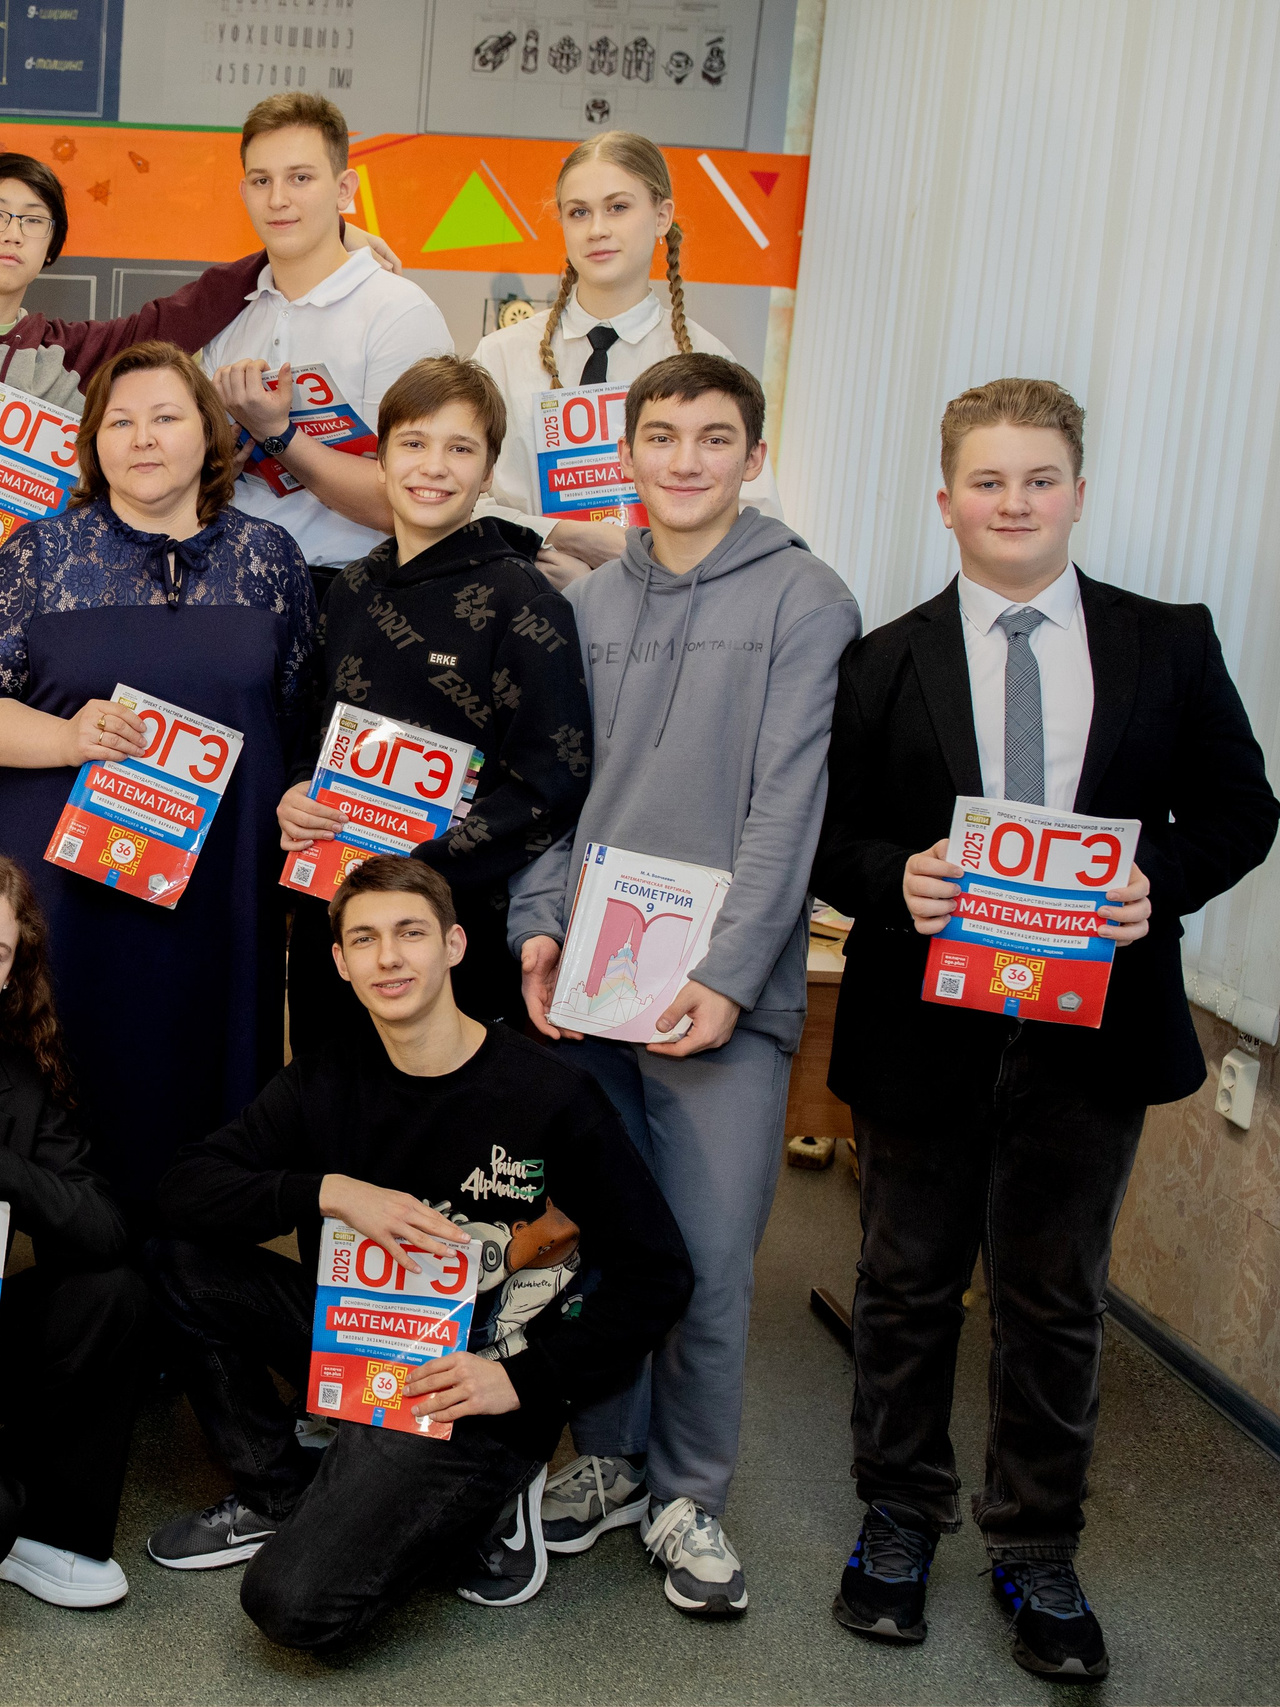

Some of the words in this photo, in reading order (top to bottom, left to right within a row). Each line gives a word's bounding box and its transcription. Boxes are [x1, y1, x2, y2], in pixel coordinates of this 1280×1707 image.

[544, 416, 560, 448] 2025
[563, 392, 627, 444] ОГ
[554, 466, 624, 487] МАТЕМАТ
[429, 653, 457, 666] ERKE
[588, 638, 675, 665] DENIM
[428, 669, 494, 729] ERKE
[134, 709, 229, 784] ОГЭ
[329, 734, 350, 769] 2025
[350, 728, 453, 799] ОГЭ
[93, 772, 195, 824] МАТЕМАТИКА
[339, 801, 408, 834] ФИЗИКА
[116, 843, 131, 856] 36
[961, 832, 984, 869] 2025
[988, 822, 1122, 887] ОГЭ
[614, 880, 693, 908] ГЕОМЕТРИЯ
[620, 874, 663, 888] МАТЕМАТИЧЕСКАЯ
[664, 884, 691, 895] ВЕРТИКАЛЬ
[646, 903, 654, 912] 9
[959, 898, 1097, 932] МАТЕМАТИКА
[1008, 968, 1027, 981] 36
[490, 1145, 538, 1179] Paint
[461, 1167, 537, 1203] Alphabet
[332, 1249, 351, 1283] 2025
[355, 1238, 468, 1295] ОГЭ
[334, 1312, 450, 1341] МАТЕМАТИКА
[377, 1376, 393, 1390] 36
